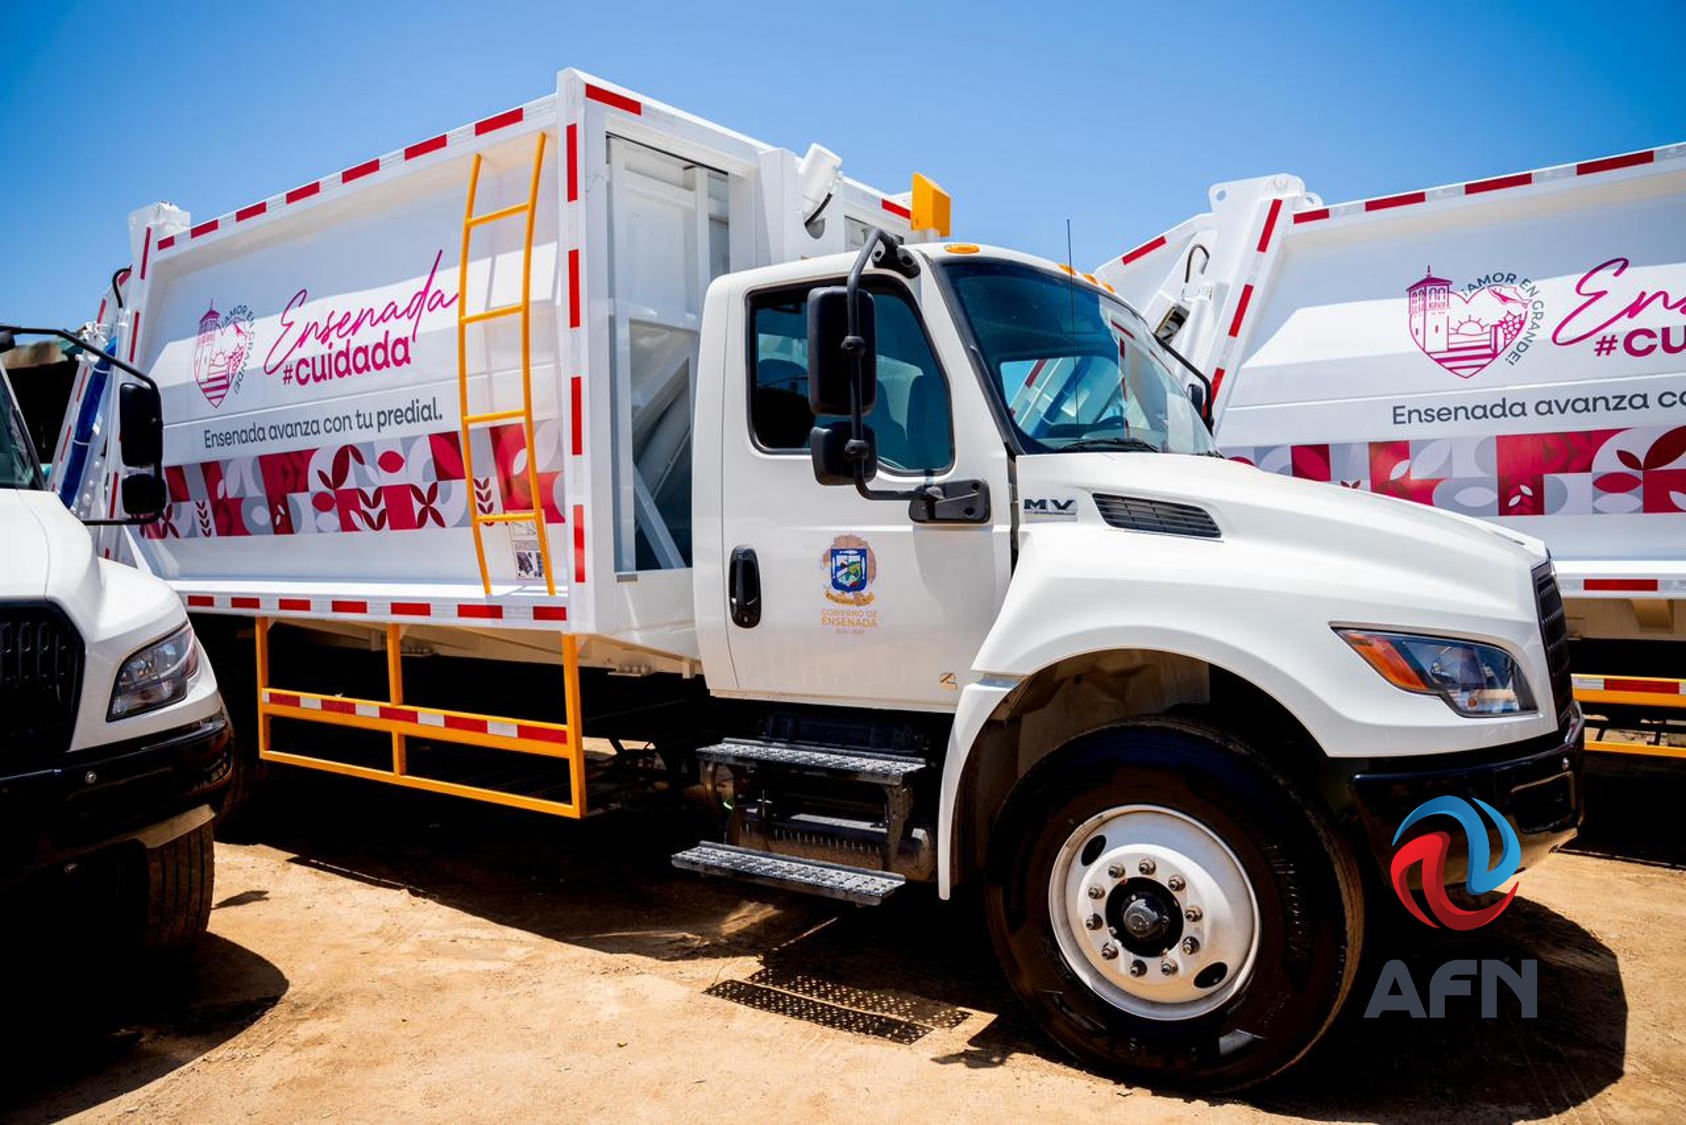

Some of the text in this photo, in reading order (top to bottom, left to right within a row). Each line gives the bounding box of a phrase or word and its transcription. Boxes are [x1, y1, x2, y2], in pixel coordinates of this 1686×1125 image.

[1519, 278, 1539, 298] EN
[263, 249, 459, 375] Ensenada
[1505, 300, 1545, 366] GRANDE!
[282, 330, 411, 386] #cuidada
[203, 396, 444, 449] Ensenada avanza con tu predial.
[1392, 397, 1528, 425] Ensenada
[1534, 392, 1650, 416] avanza
[1024, 498, 1075, 510] MV
[821, 617, 878, 628] ENSENADA
